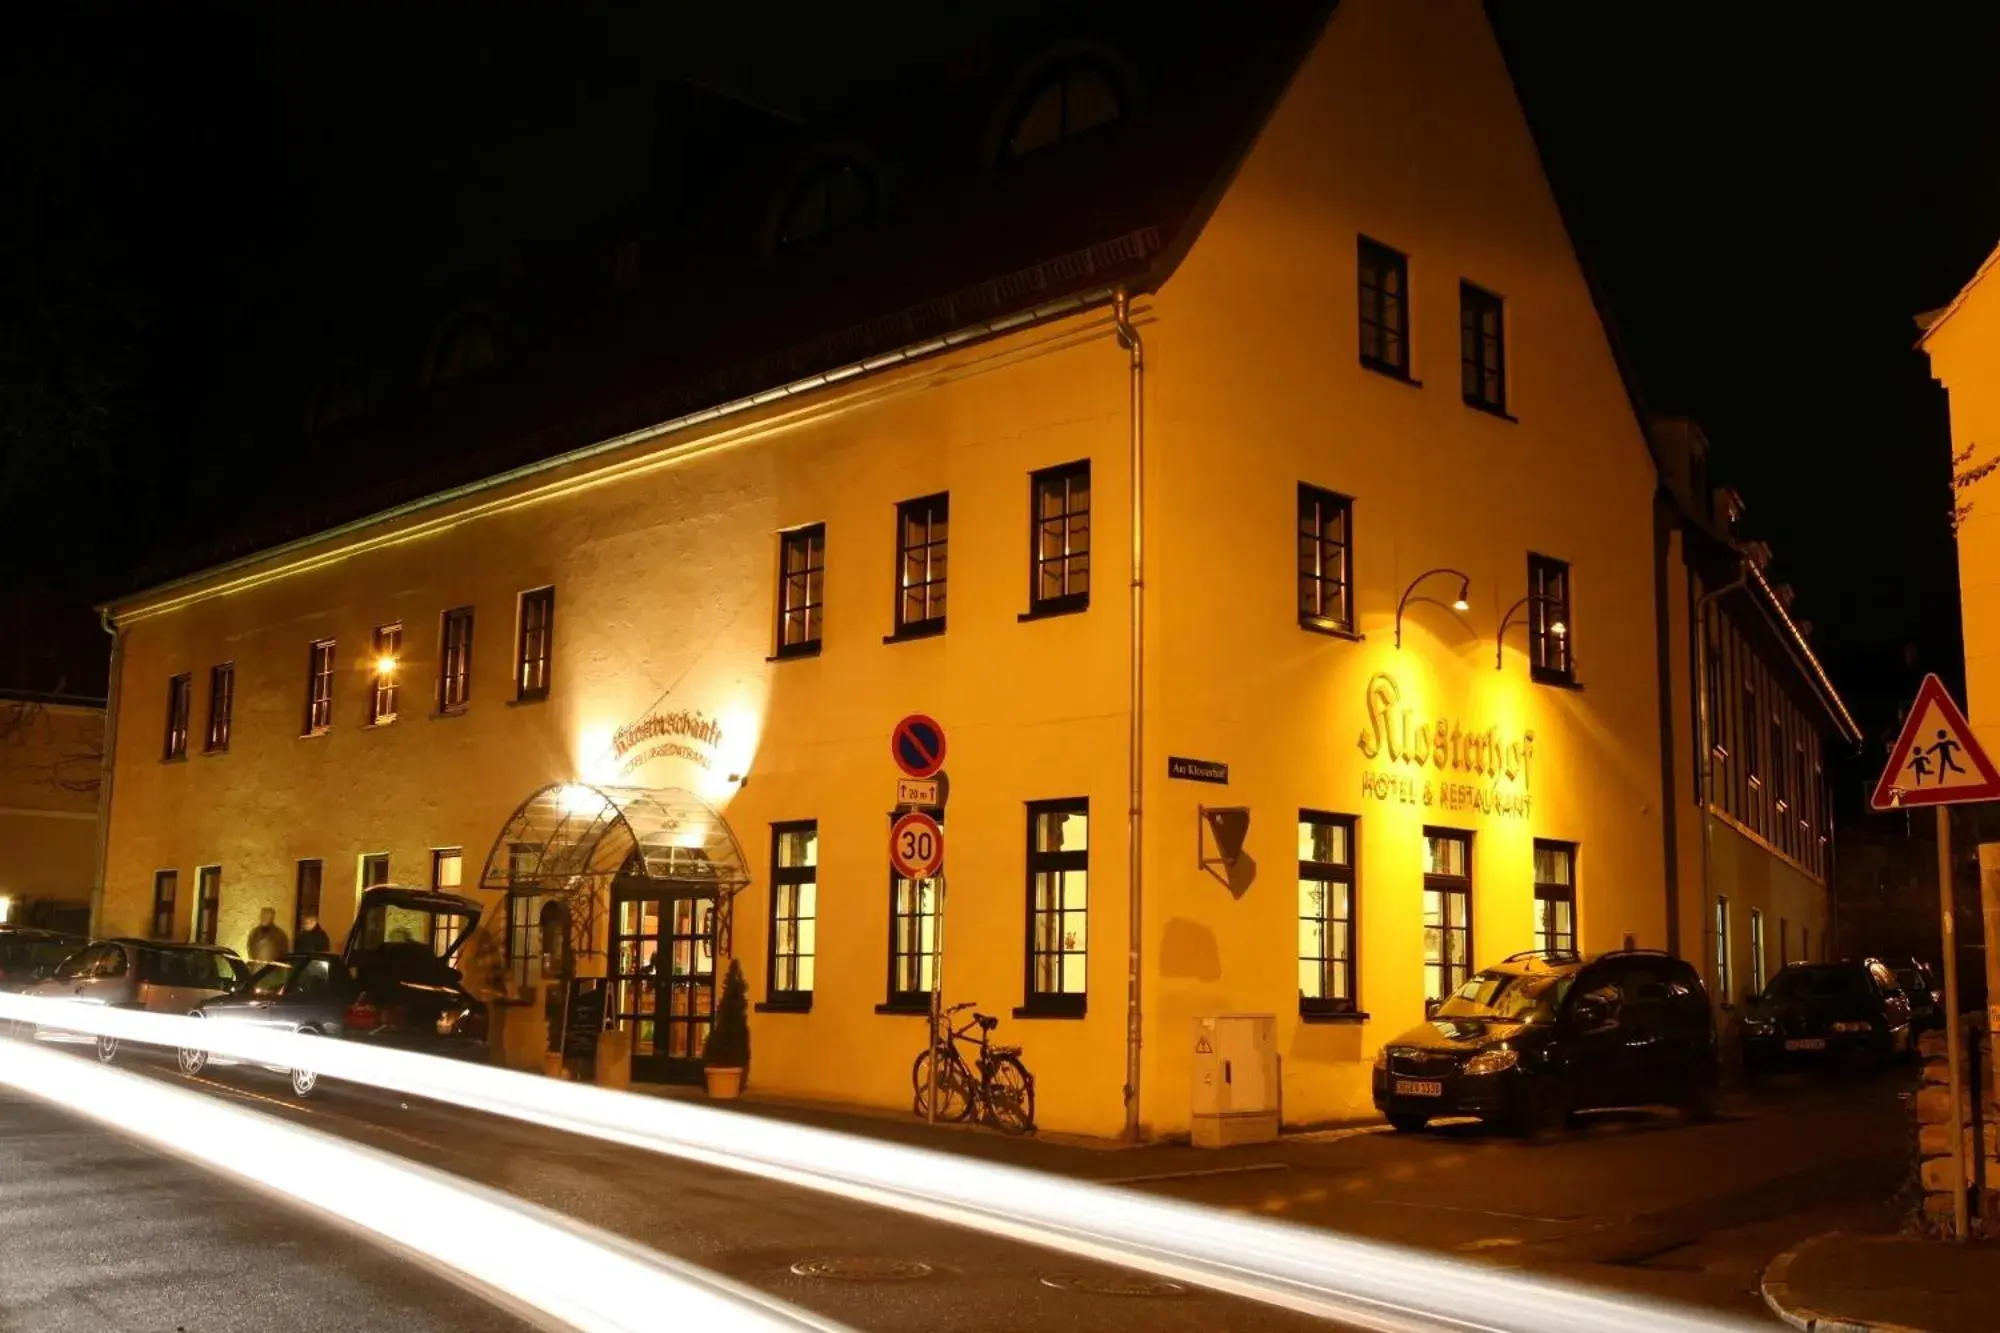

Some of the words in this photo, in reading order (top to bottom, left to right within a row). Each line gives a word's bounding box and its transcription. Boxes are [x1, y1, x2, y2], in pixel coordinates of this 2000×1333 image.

[1357, 672, 1535, 792] Klosterhof
[1362, 770, 1416, 806] HOTEL
[1422, 779, 1433, 806] &
[1439, 781, 1533, 820] RESTAURANT
[902, 831, 931, 861] 30
